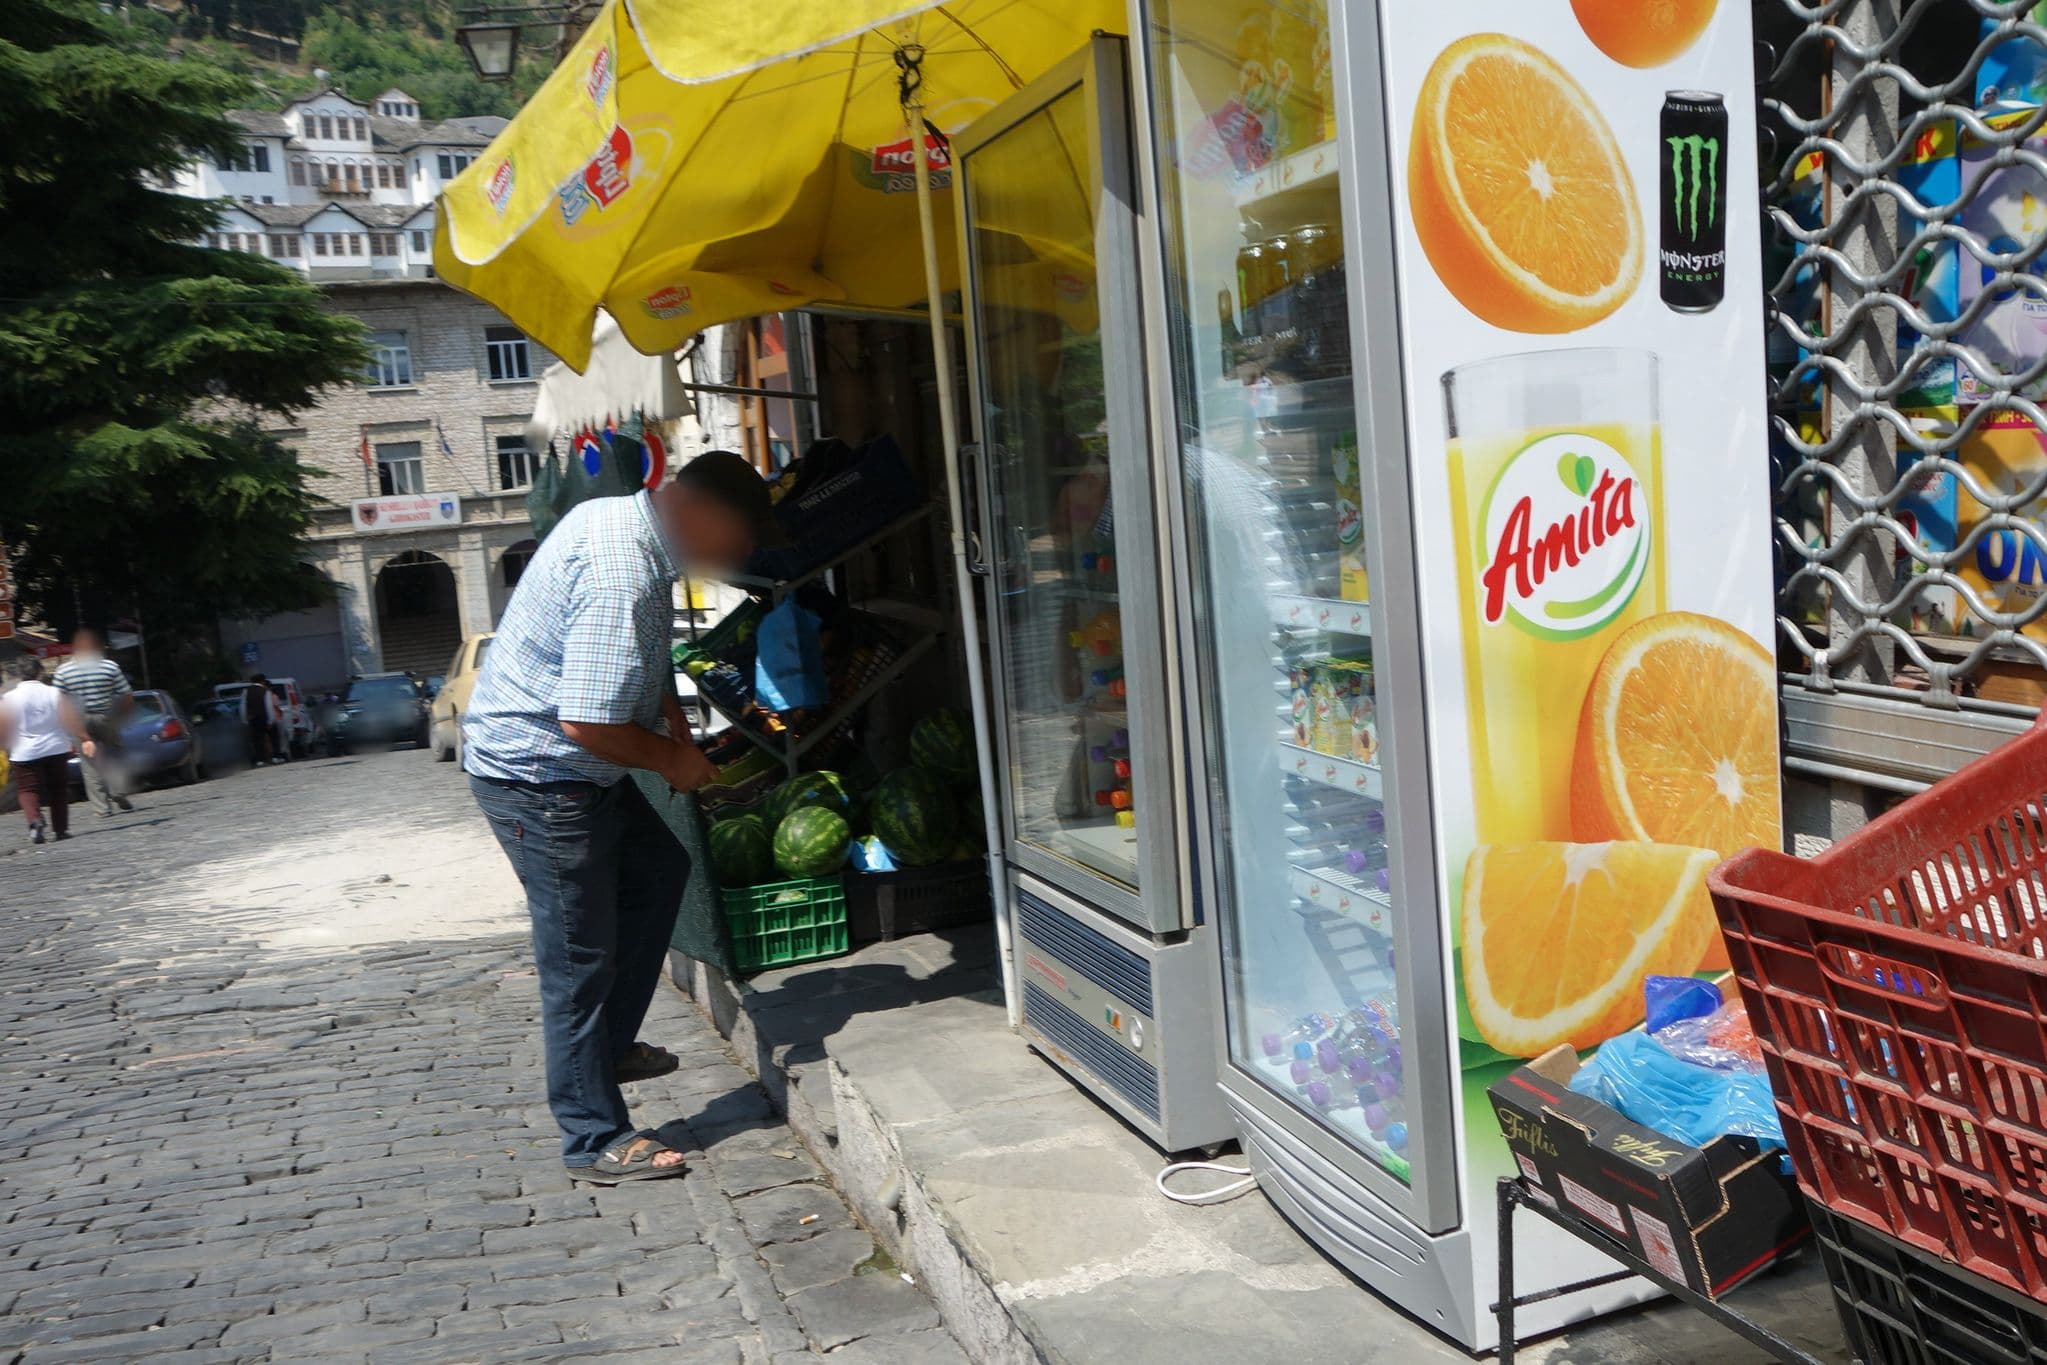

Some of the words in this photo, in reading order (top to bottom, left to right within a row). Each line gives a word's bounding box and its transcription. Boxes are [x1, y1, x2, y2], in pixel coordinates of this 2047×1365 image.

[1660, 247, 1726, 272] MONSTER
[1667, 270, 1720, 282] ENERGY
[1483, 467, 1635, 622] Amita
